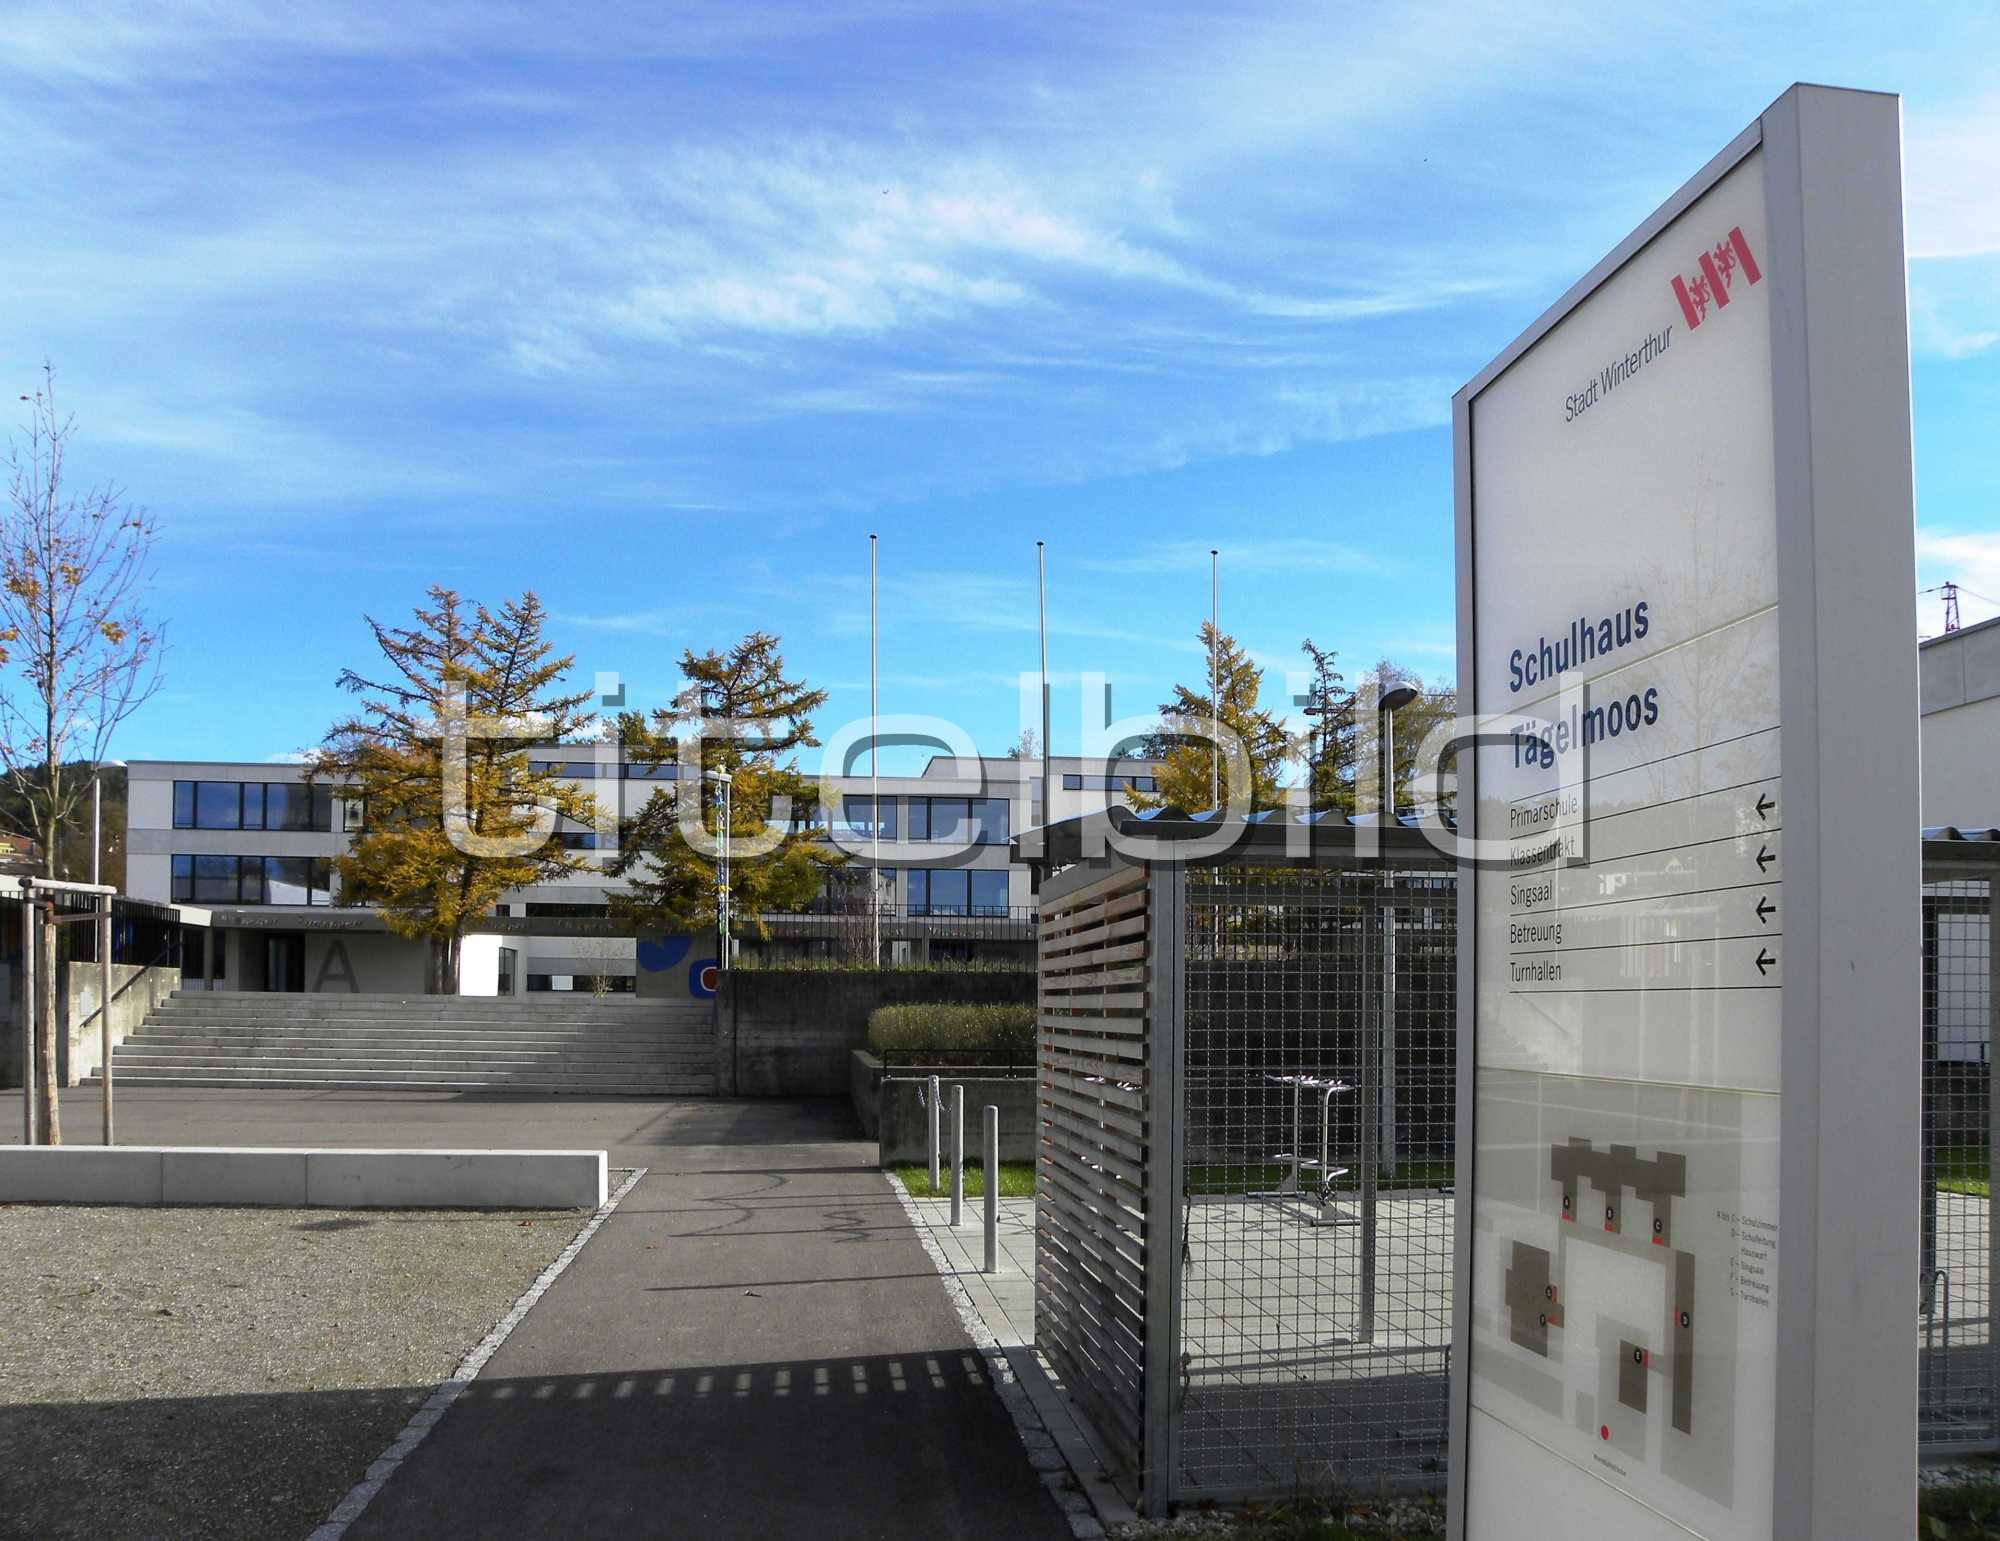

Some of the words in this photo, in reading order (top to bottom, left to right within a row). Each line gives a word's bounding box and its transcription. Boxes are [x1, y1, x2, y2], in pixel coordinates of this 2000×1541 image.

[1565, 379, 1599, 422] Stadt
[1600, 326, 1673, 395] Winterthur
[1509, 601, 1649, 693] Schulhaus
[1510, 687, 1659, 770] Tägelmoos
[1510, 793, 1578, 829] Primarschule
[1510, 835, 1576, 867] Klassentrakt
[1510, 880, 1552, 907] Singsaal
[1510, 922, 1562, 944] Betreuung
[312, 939, 361, 993] A
[1510, 960, 1562, 983] Turnhallen
